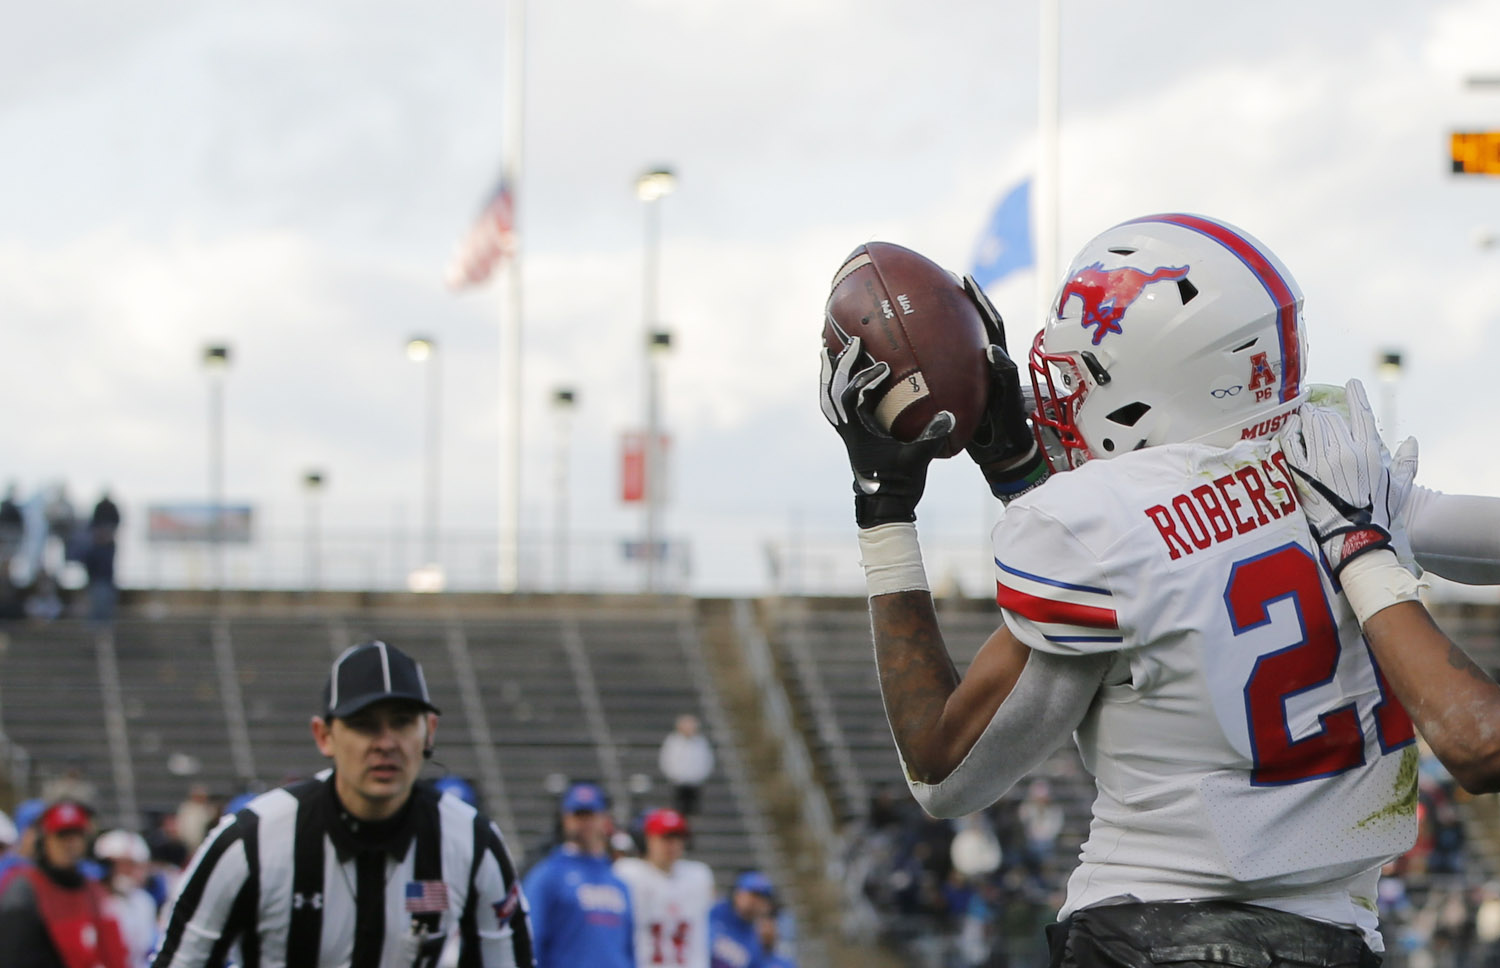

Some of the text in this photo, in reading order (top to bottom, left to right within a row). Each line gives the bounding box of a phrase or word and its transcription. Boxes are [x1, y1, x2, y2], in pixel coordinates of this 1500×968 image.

[1248, 352, 1276, 391] A
[1255, 387, 1273, 403] P6
[1241, 404, 1304, 440] MUST
[1144, 450, 1301, 560] ROBERS
